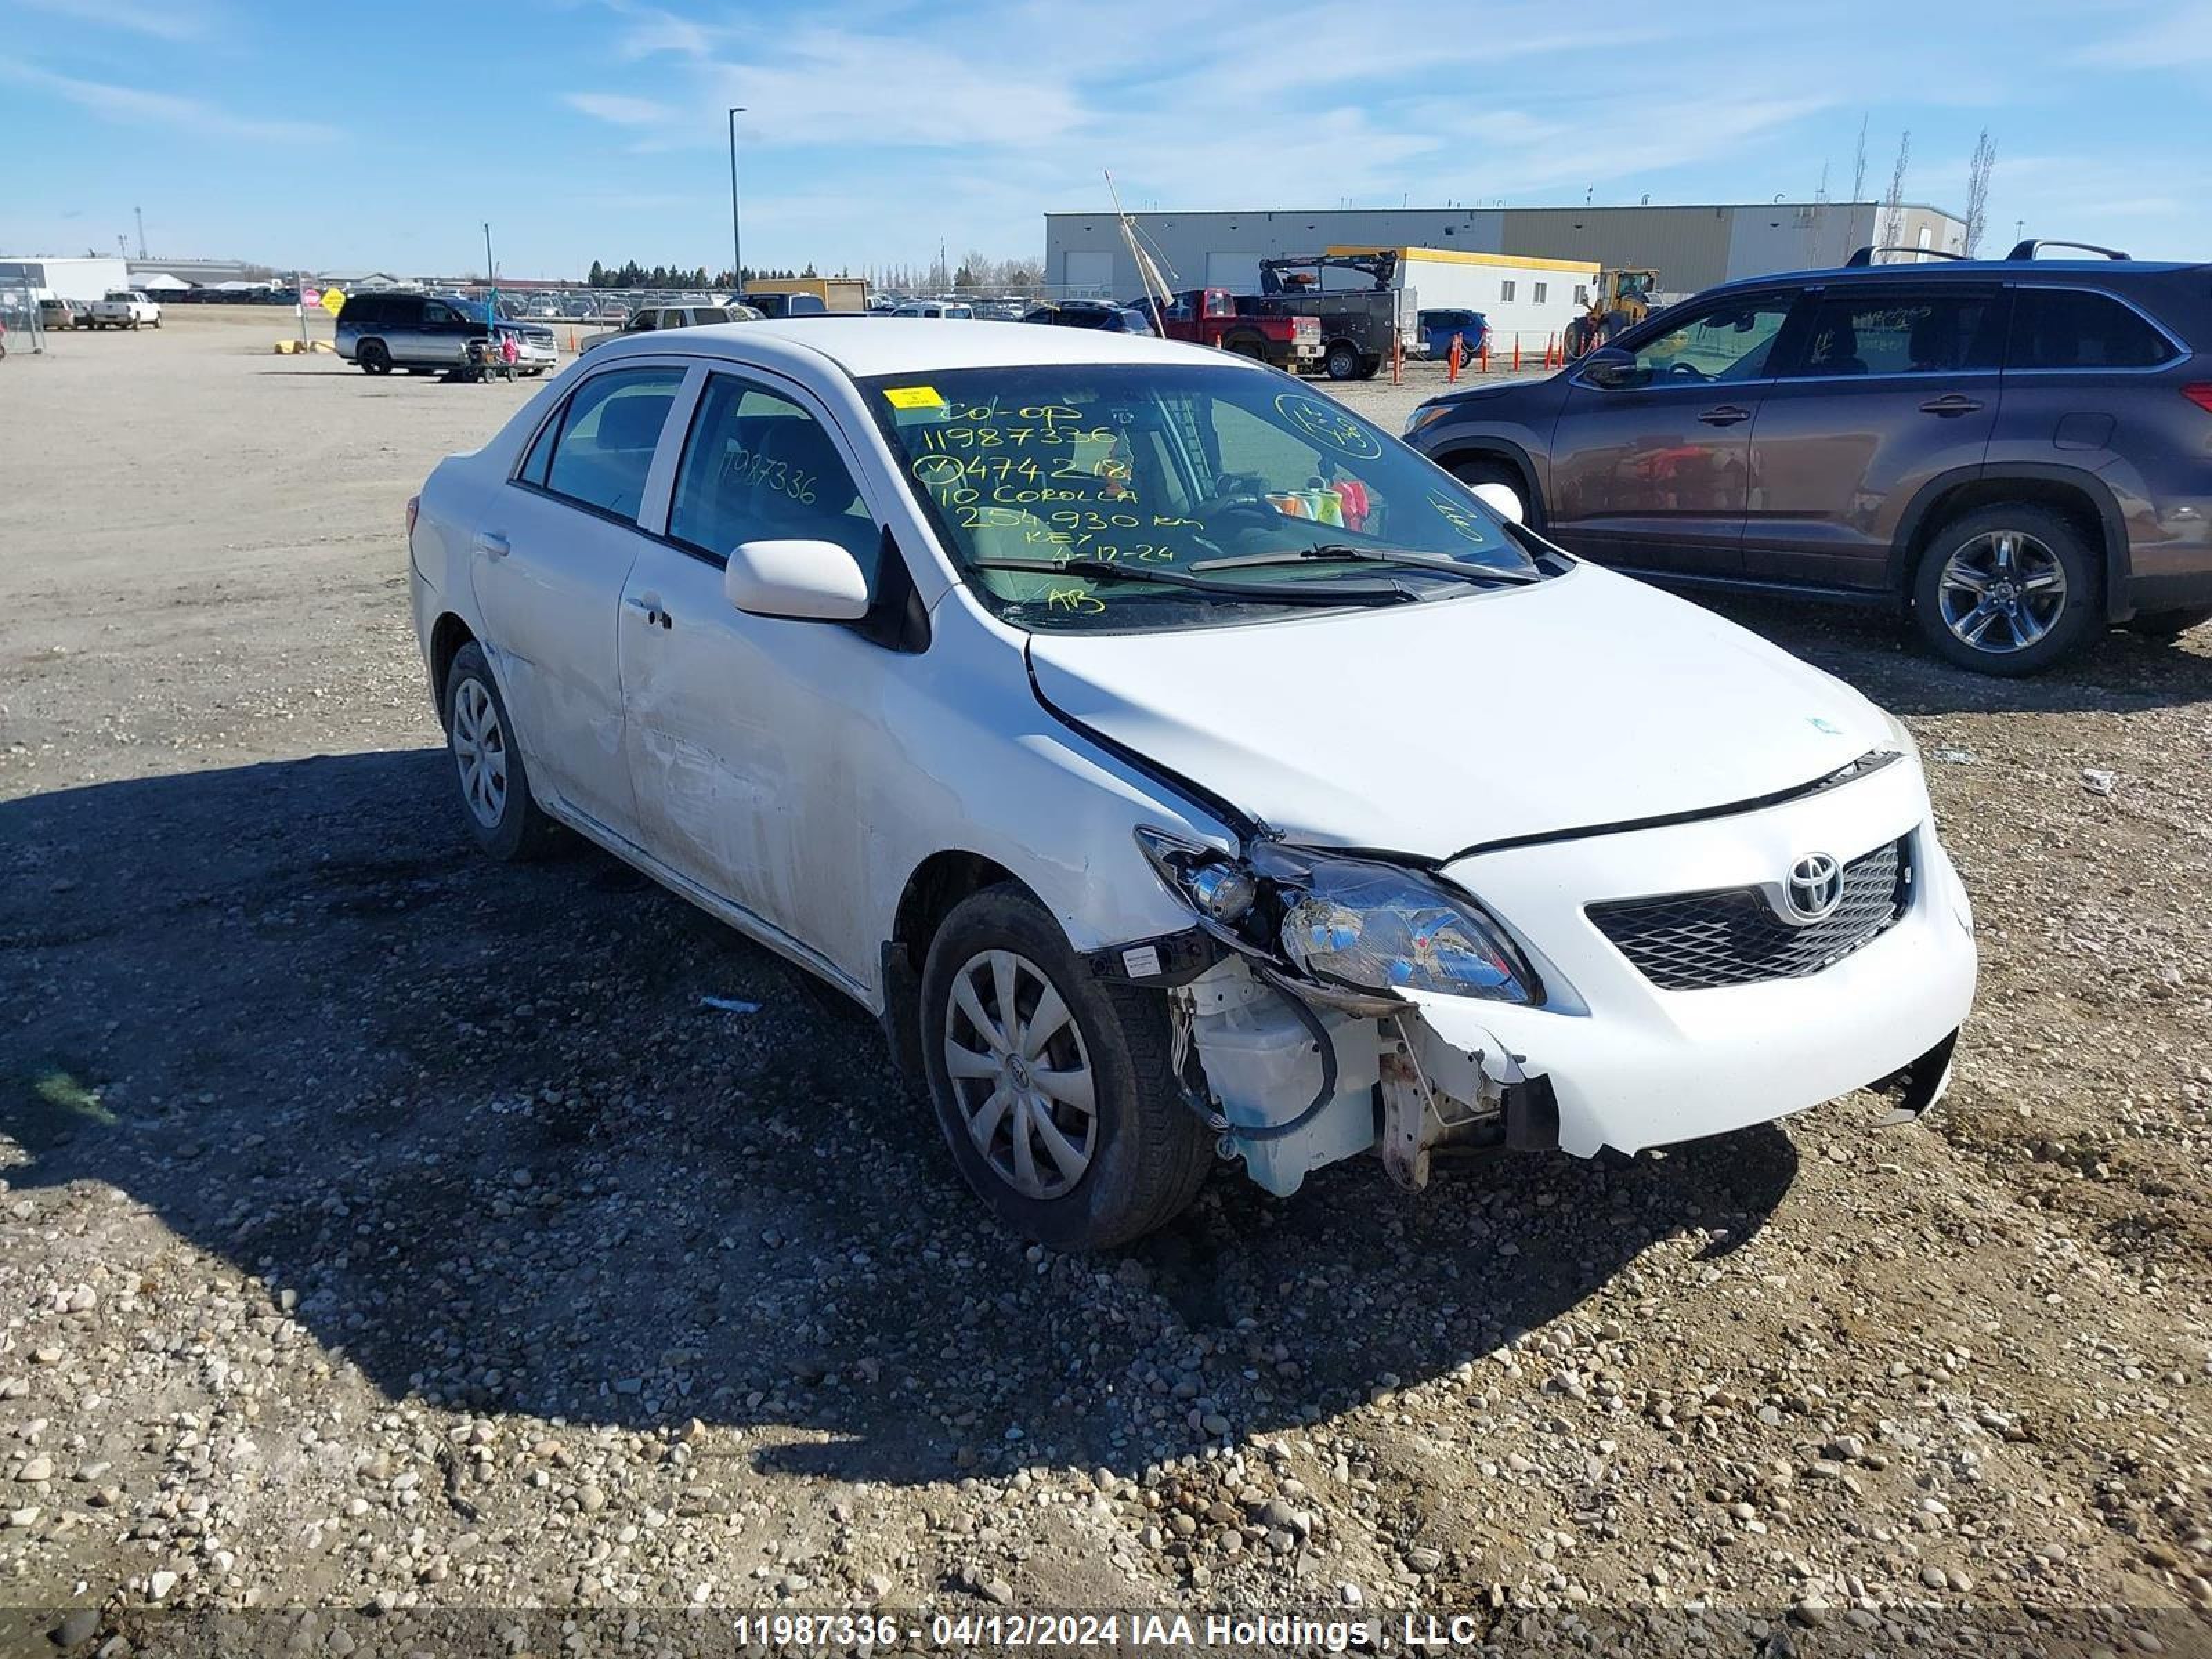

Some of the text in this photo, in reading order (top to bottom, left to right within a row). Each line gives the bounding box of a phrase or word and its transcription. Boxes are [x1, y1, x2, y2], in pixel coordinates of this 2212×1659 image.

[923, 427, 1118, 450] 11987336
[942, 487, 980, 507] 10
[1026, 532, 1093, 547] KEY
